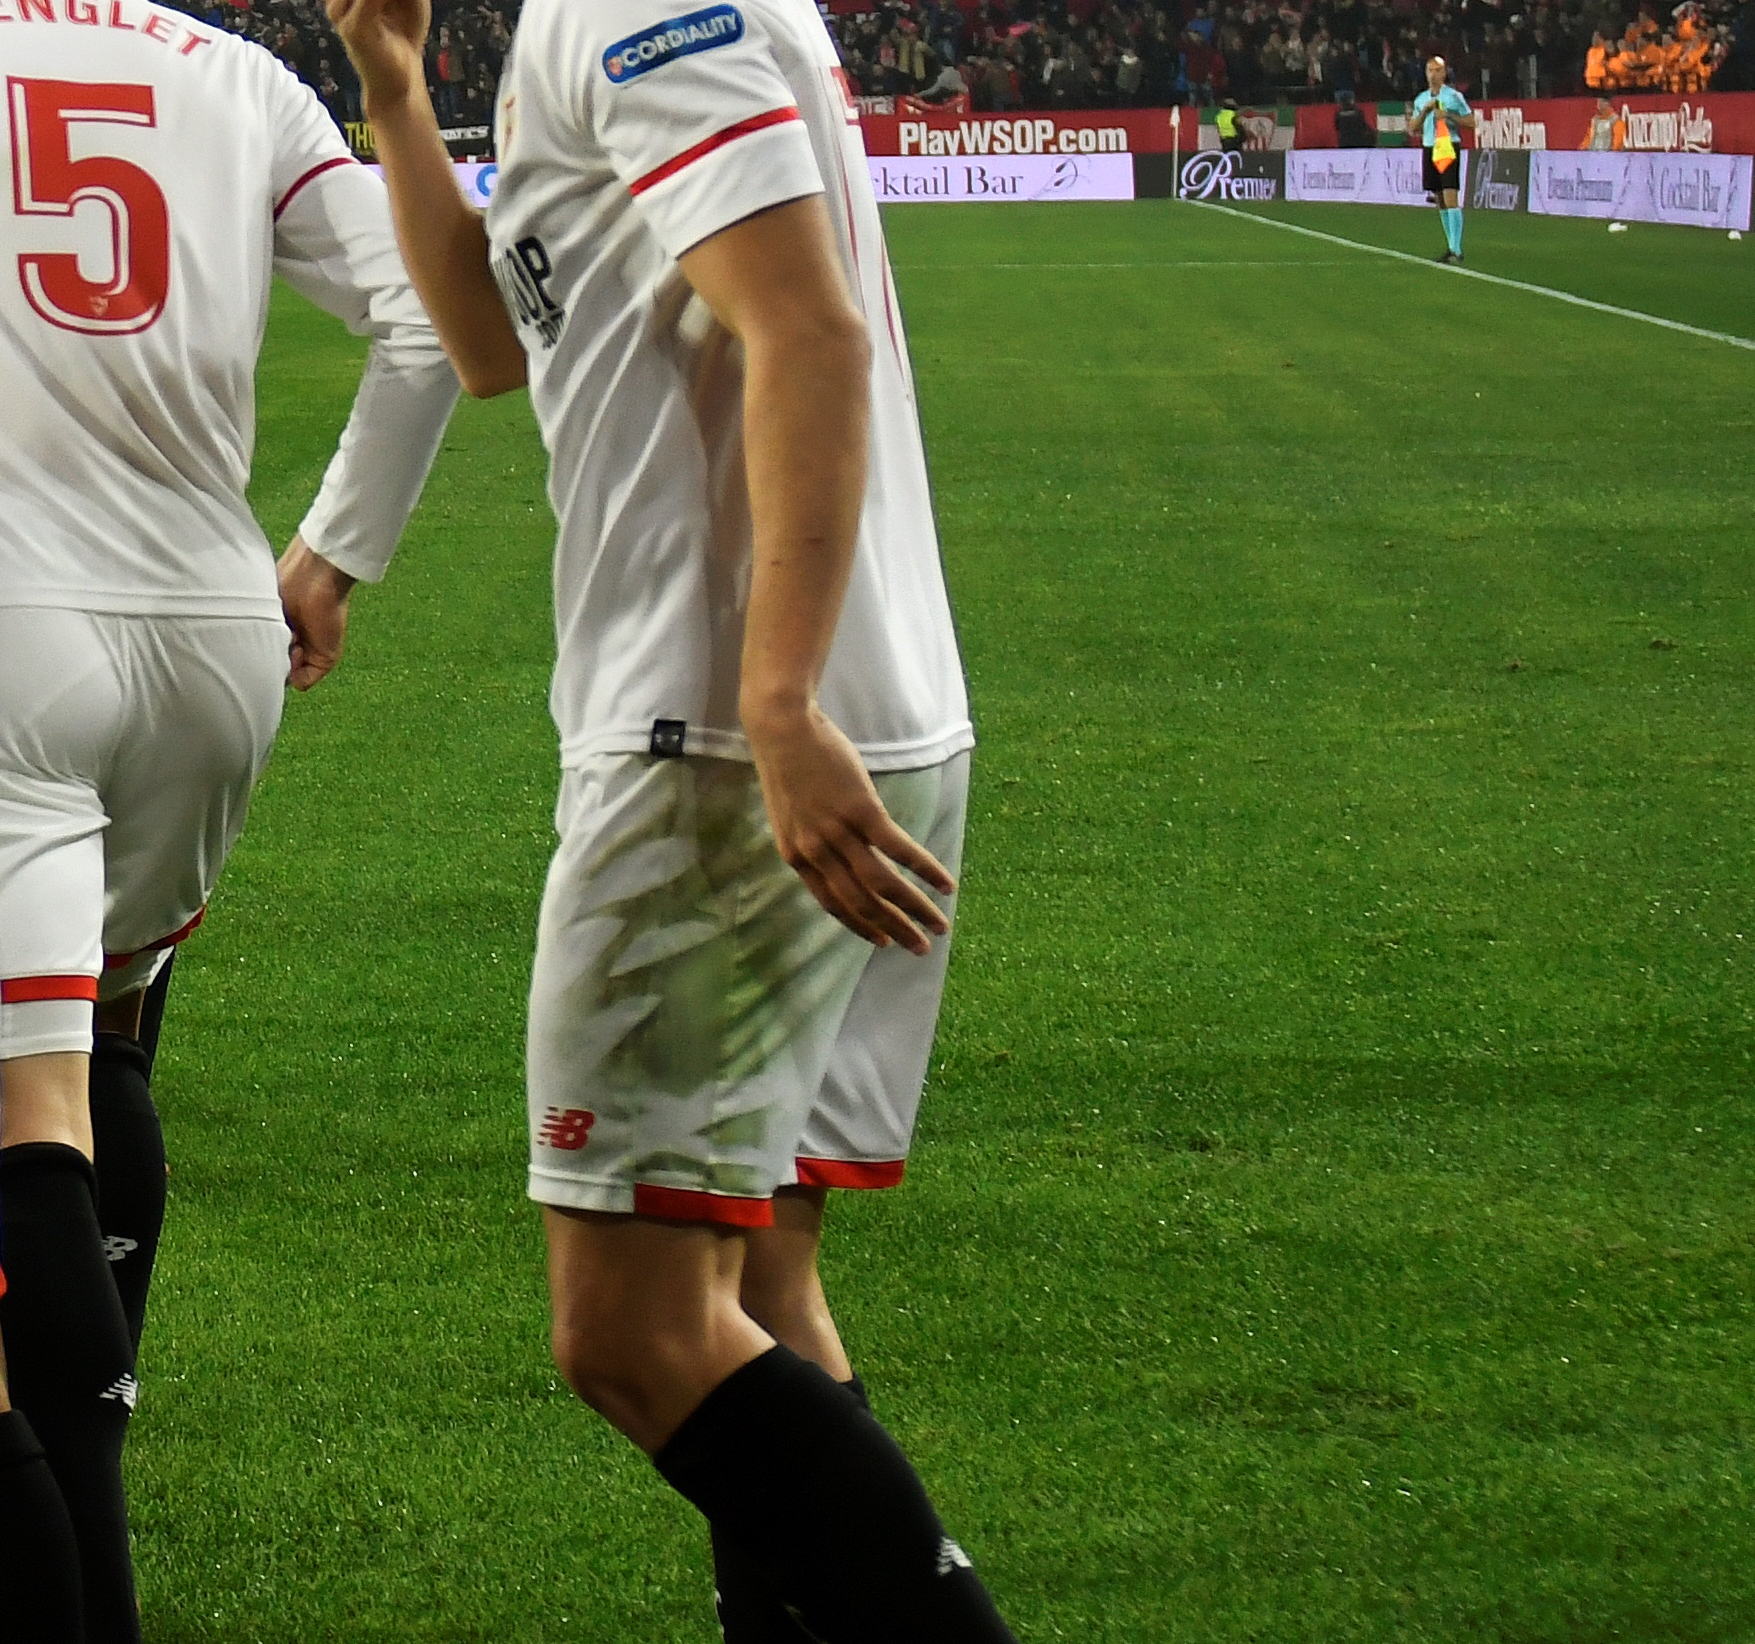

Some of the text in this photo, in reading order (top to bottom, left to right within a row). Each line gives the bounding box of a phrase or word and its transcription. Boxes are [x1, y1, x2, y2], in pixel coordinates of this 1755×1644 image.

[619, 14, 738, 69] CORDIALITY
[898, 119, 1128, 155] PlayWSOP.com
[1474, 108, 1546, 149] PlayWSOP.com
[964, 167, 1024, 194] Bar
[1179, 150, 1276, 199] Premier
[6, 77, 170, 336] 5
